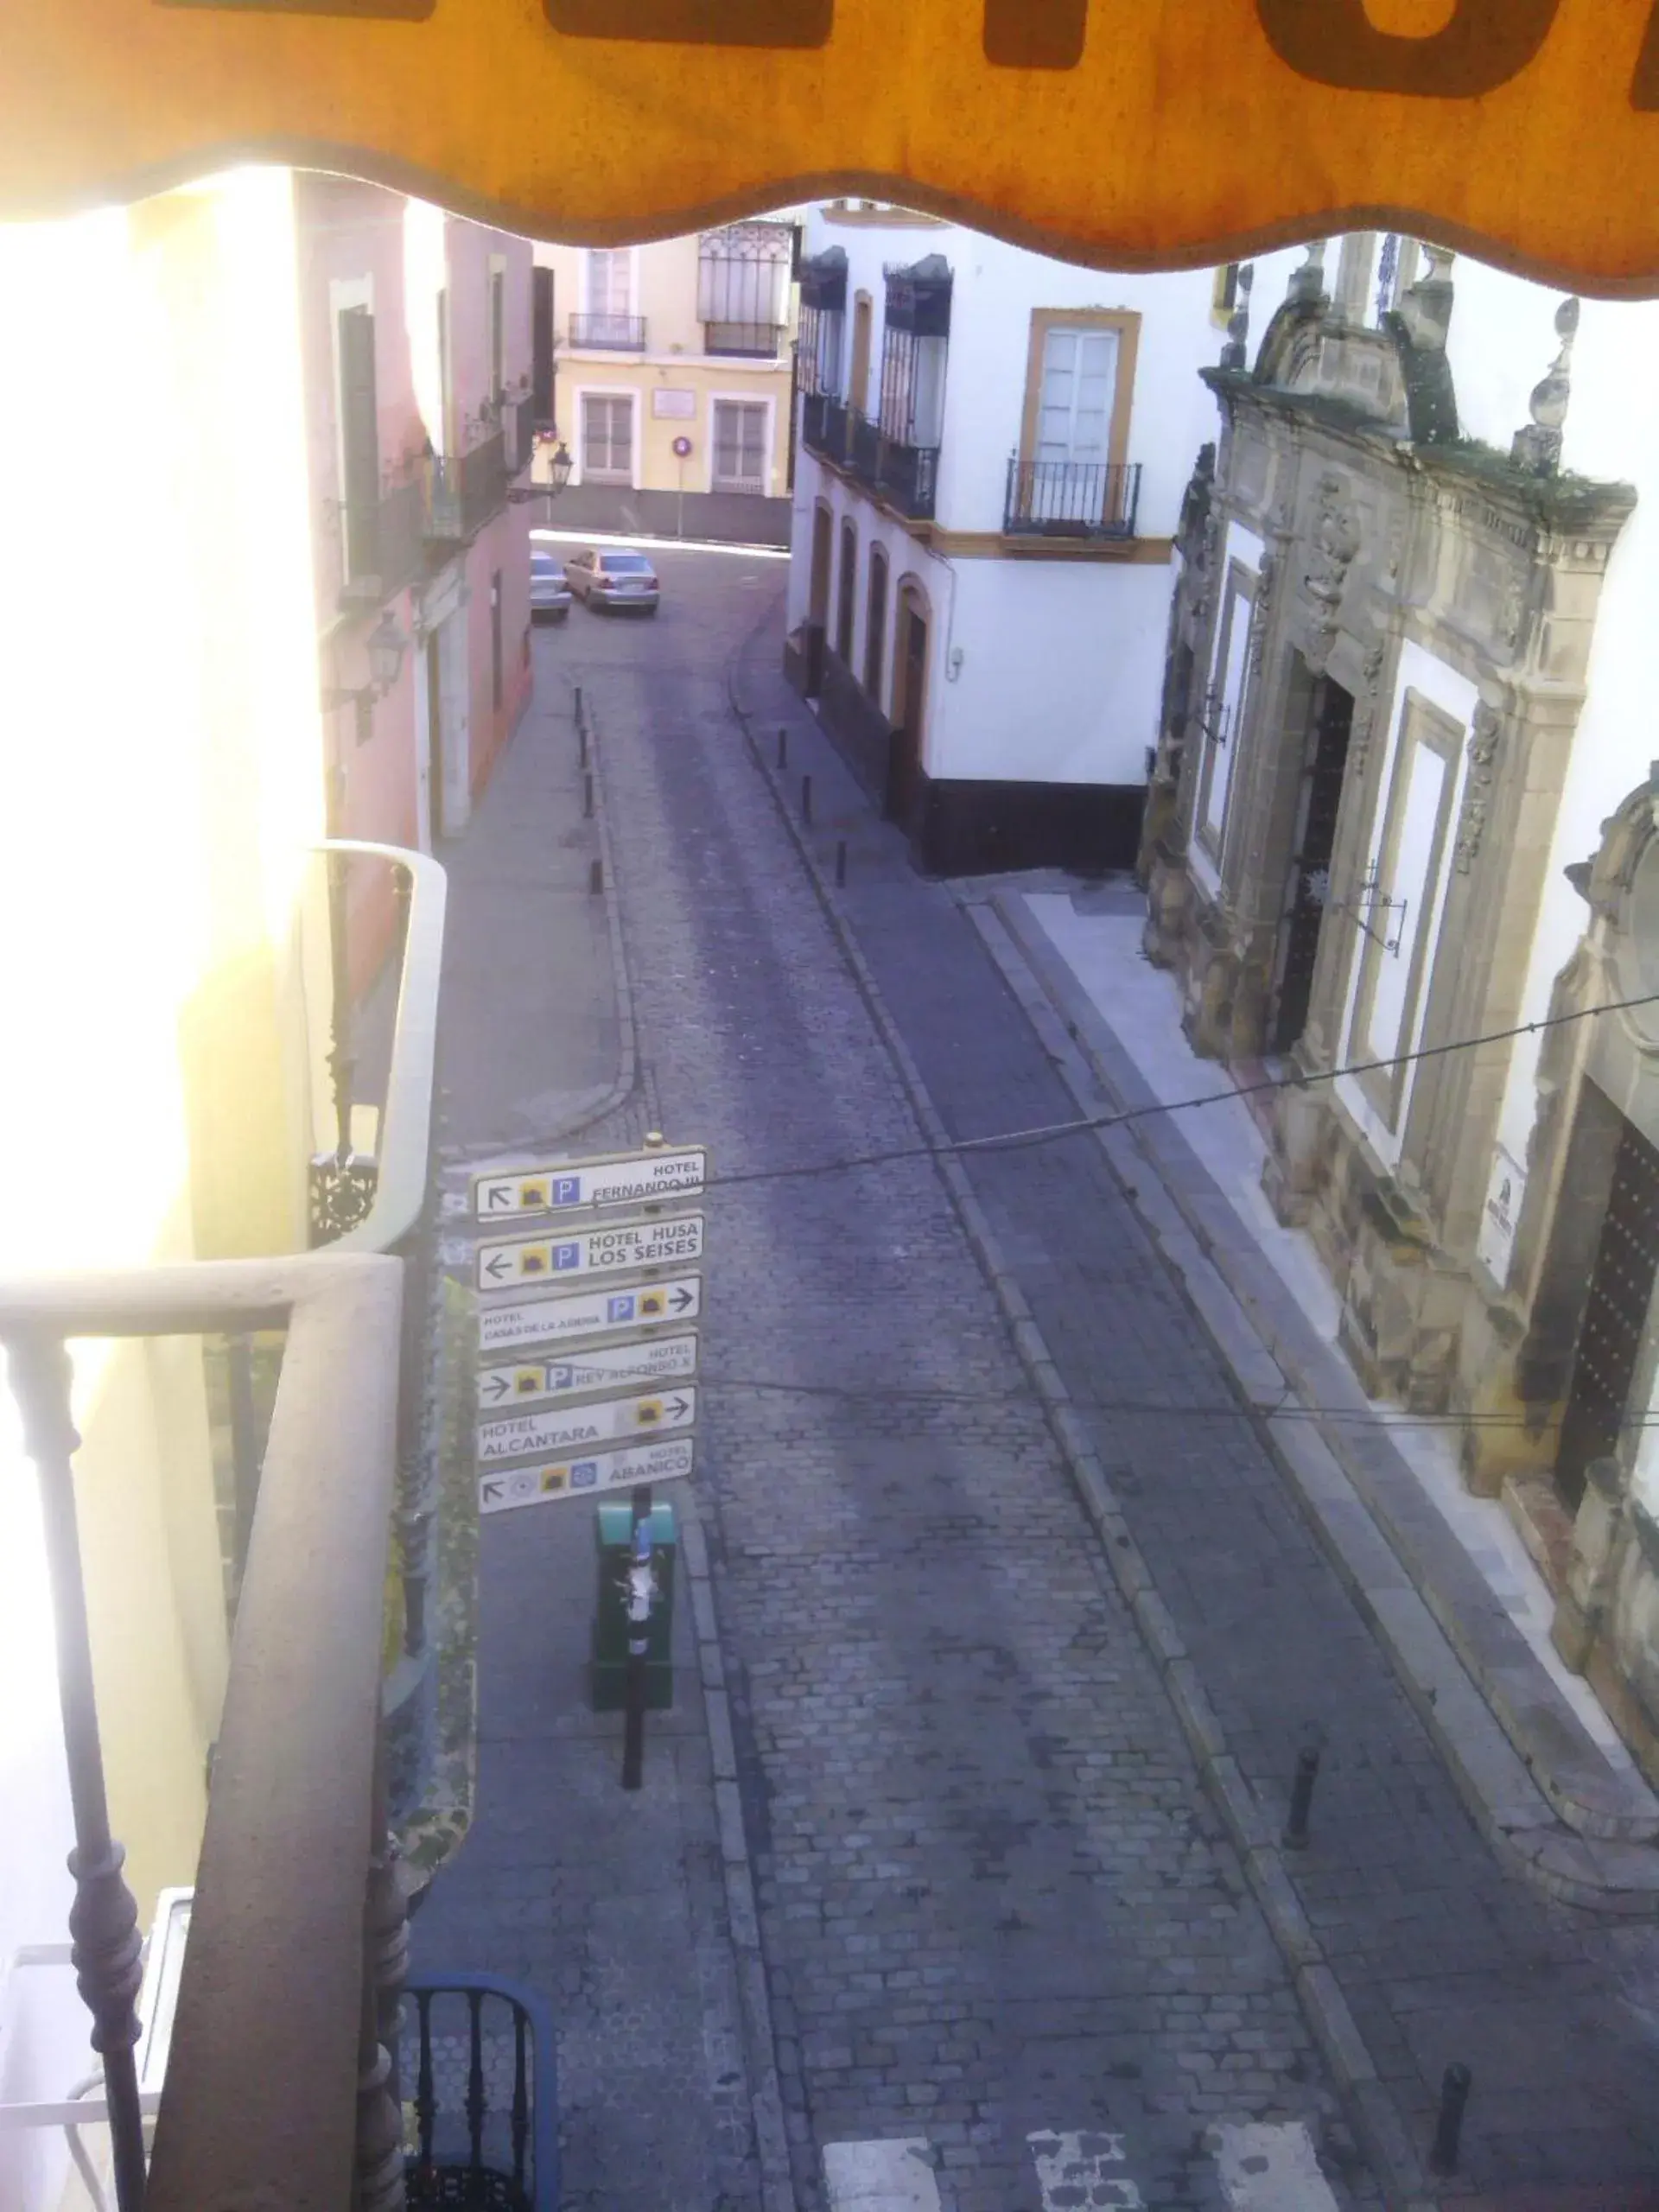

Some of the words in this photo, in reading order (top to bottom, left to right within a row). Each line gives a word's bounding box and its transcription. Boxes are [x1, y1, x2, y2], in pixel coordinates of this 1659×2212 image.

[653, 1161, 699, 1176] HOTEL
[593, 1179, 681, 1200] FERNANDO
[588, 1232, 642, 1249] HOTEL
[652, 1223, 698, 1241] HUSA
[588, 1249, 626, 1268] LOS
[635, 1238, 697, 1262] SEISES
[484, 1313, 524, 1325] HOTEL
[650, 1344, 690, 1359] HOTEL
[482, 1415, 537, 1439] HOTEL
[483, 1426, 599, 1457] ALCANTARA
[650, 1445, 689, 1460] HOTEL
[609, 1455, 690, 1482] ABANICO
